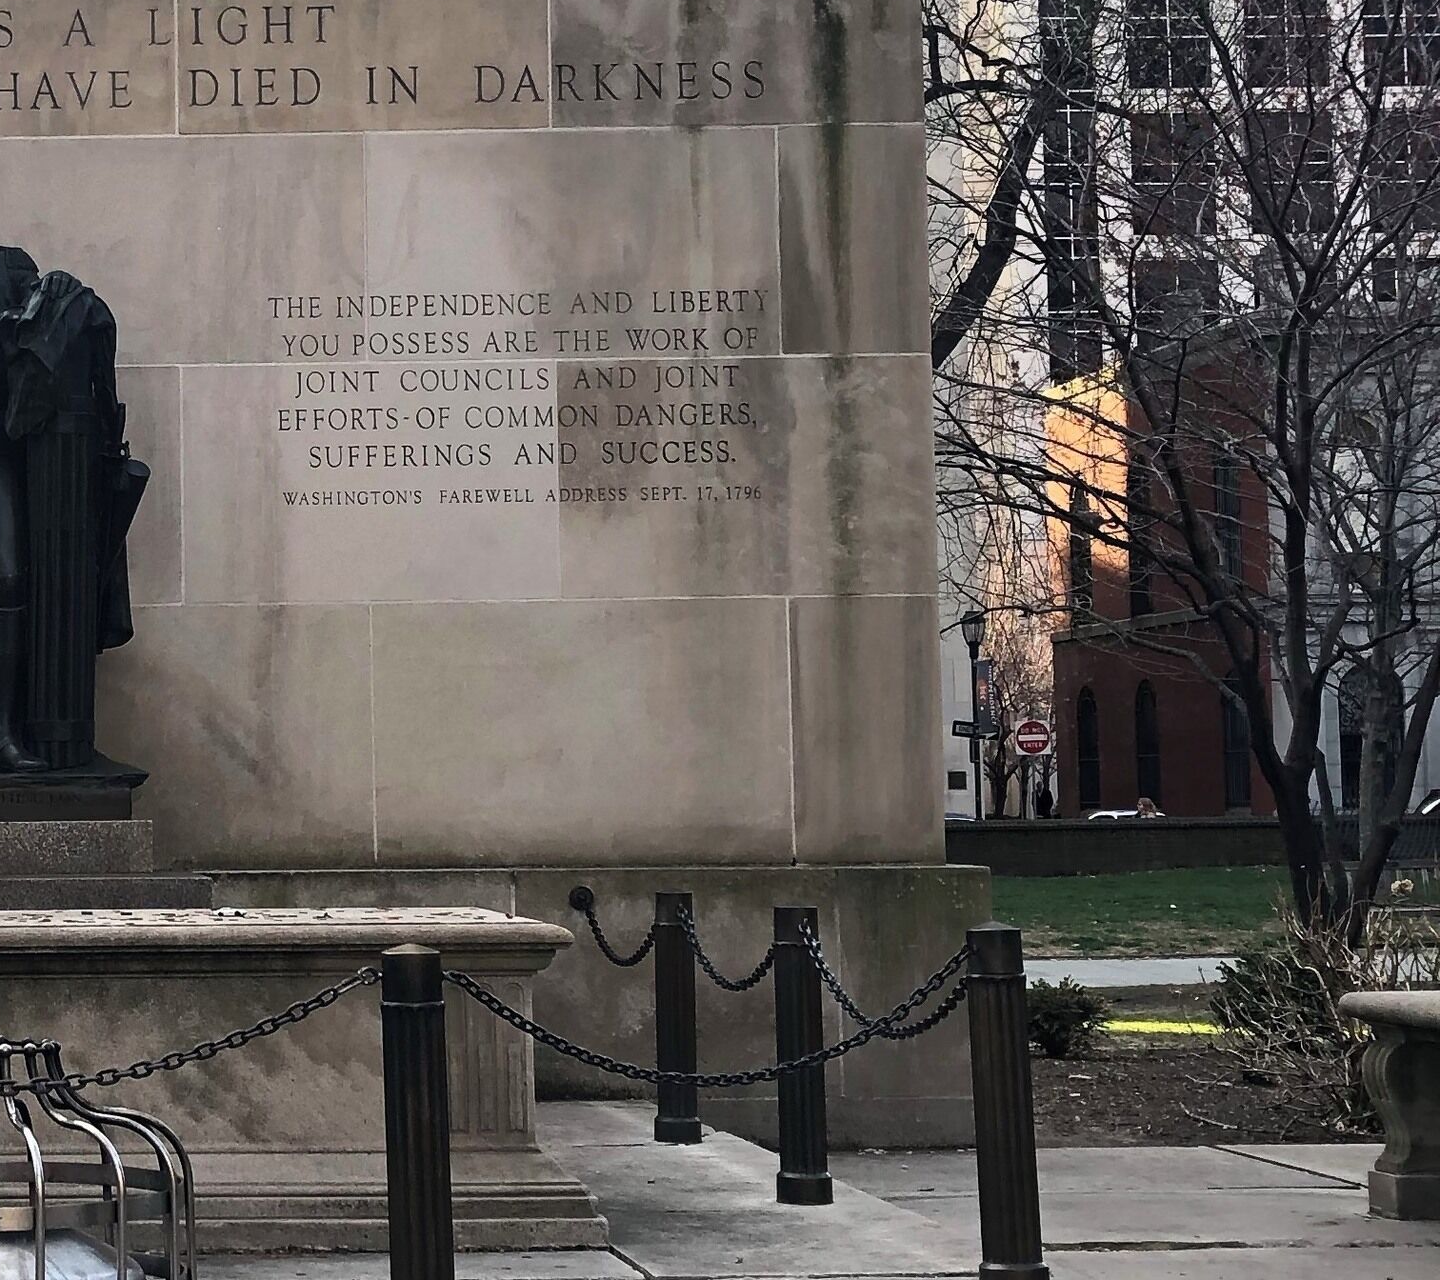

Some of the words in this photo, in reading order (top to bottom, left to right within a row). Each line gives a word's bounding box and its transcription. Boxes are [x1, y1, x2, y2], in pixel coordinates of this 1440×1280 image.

[63, 8, 96, 48] A
[148, 4, 336, 47] LIGHT
[189, 66, 323, 109] DIED
[366, 64, 419, 105] IN
[474, 59, 766, 104] DARKNESS
[268, 296, 322, 319] THE
[335, 293, 551, 318] INDEPENDENCE
[570, 291, 633, 315] AND
[652, 289, 769, 313] LIBERTY
[282, 334, 340, 357] YOU
[352, 331, 470, 356] POSSESS
[483, 330, 538, 353] ARE
[553, 329, 611, 352] THE
[625, 328, 709, 351] WORK
[724, 327, 759, 350] OF
[295, 370, 380, 398] JOINT
[400, 368, 550, 392] COUNCILS
[572, 367, 637, 389] AND
[652, 364, 740, 392] JOINT
[464, 404, 600, 429] COMMON
[615, 401, 757, 428] DANGERS,
[309, 443, 491, 468] SUFFERINGS
[514, 442, 578, 465] AND
[601, 440, 737, 465] SUCCESS.
[283, 488, 422, 506] WASHINGTON'S
[439, 488, 534, 503] FAREWELL
[545, 487, 628, 503] ADDRESS
[640, 486, 687, 502] SEPT.
[697, 486, 718, 503] 17,
[725, 485, 762, 500] 1796
